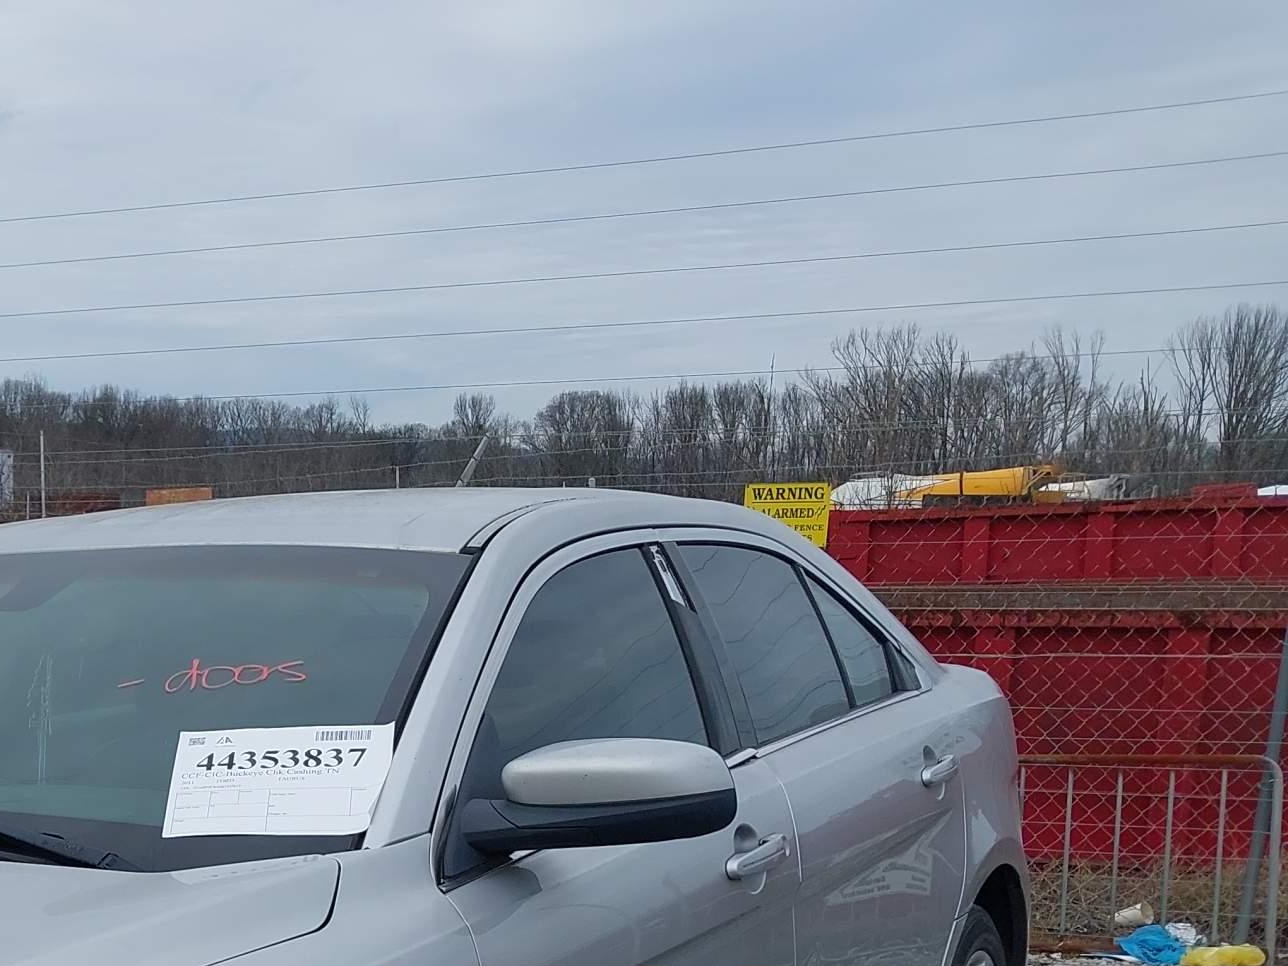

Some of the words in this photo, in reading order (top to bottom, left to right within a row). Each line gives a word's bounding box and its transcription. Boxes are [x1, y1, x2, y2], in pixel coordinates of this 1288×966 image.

[752, 486, 825, 500] WARNING
[794, 524, 825, 532] FENCE
[196, 748, 368, 771] 44353837
